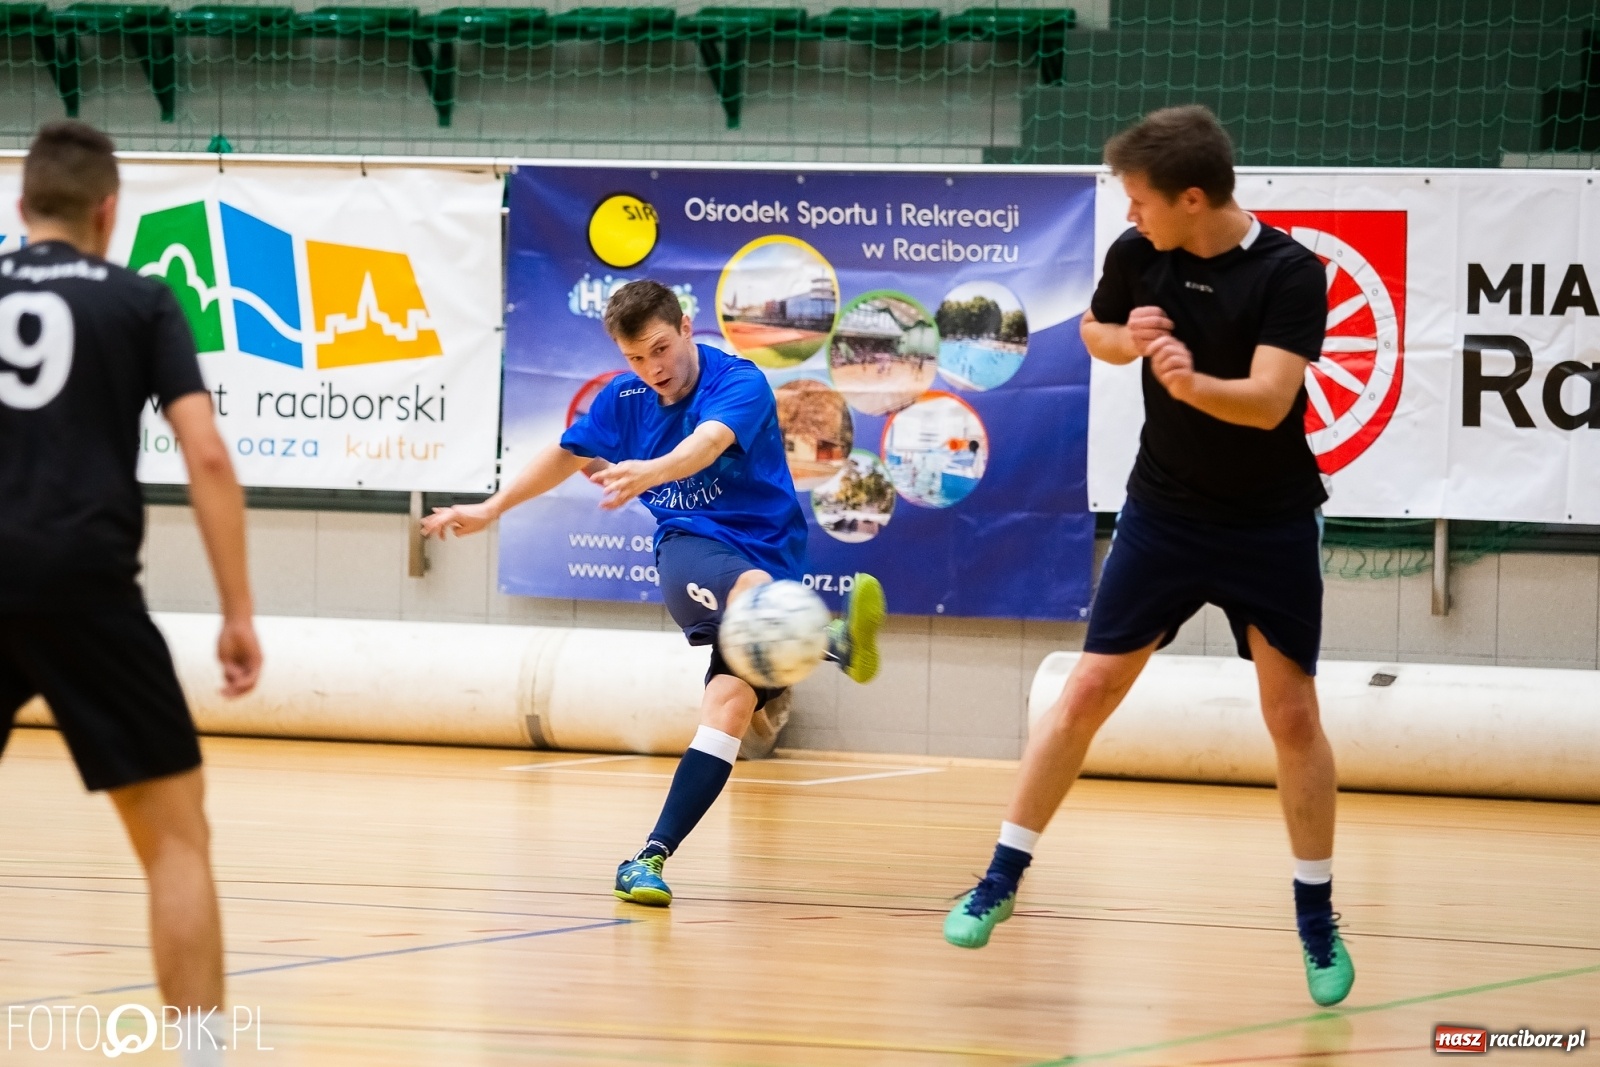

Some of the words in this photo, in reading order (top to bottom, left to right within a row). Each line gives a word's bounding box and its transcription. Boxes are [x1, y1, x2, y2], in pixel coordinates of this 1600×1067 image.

[684, 197, 790, 224] Ośrodek
[797, 201, 877, 229] Sportu
[886, 204, 892, 226] i
[901, 203, 1020, 233] Rekreacji
[862, 242, 885, 259] w
[893, 238, 1018, 264] Raciborzu
[1467, 263, 1600, 316] MIA
[0, 291, 75, 410] 9
[257, 382, 445, 422] raciborski
[237, 437, 319, 457] oaza
[345, 434, 445, 461] kultur
[686, 582, 718, 611] 8
